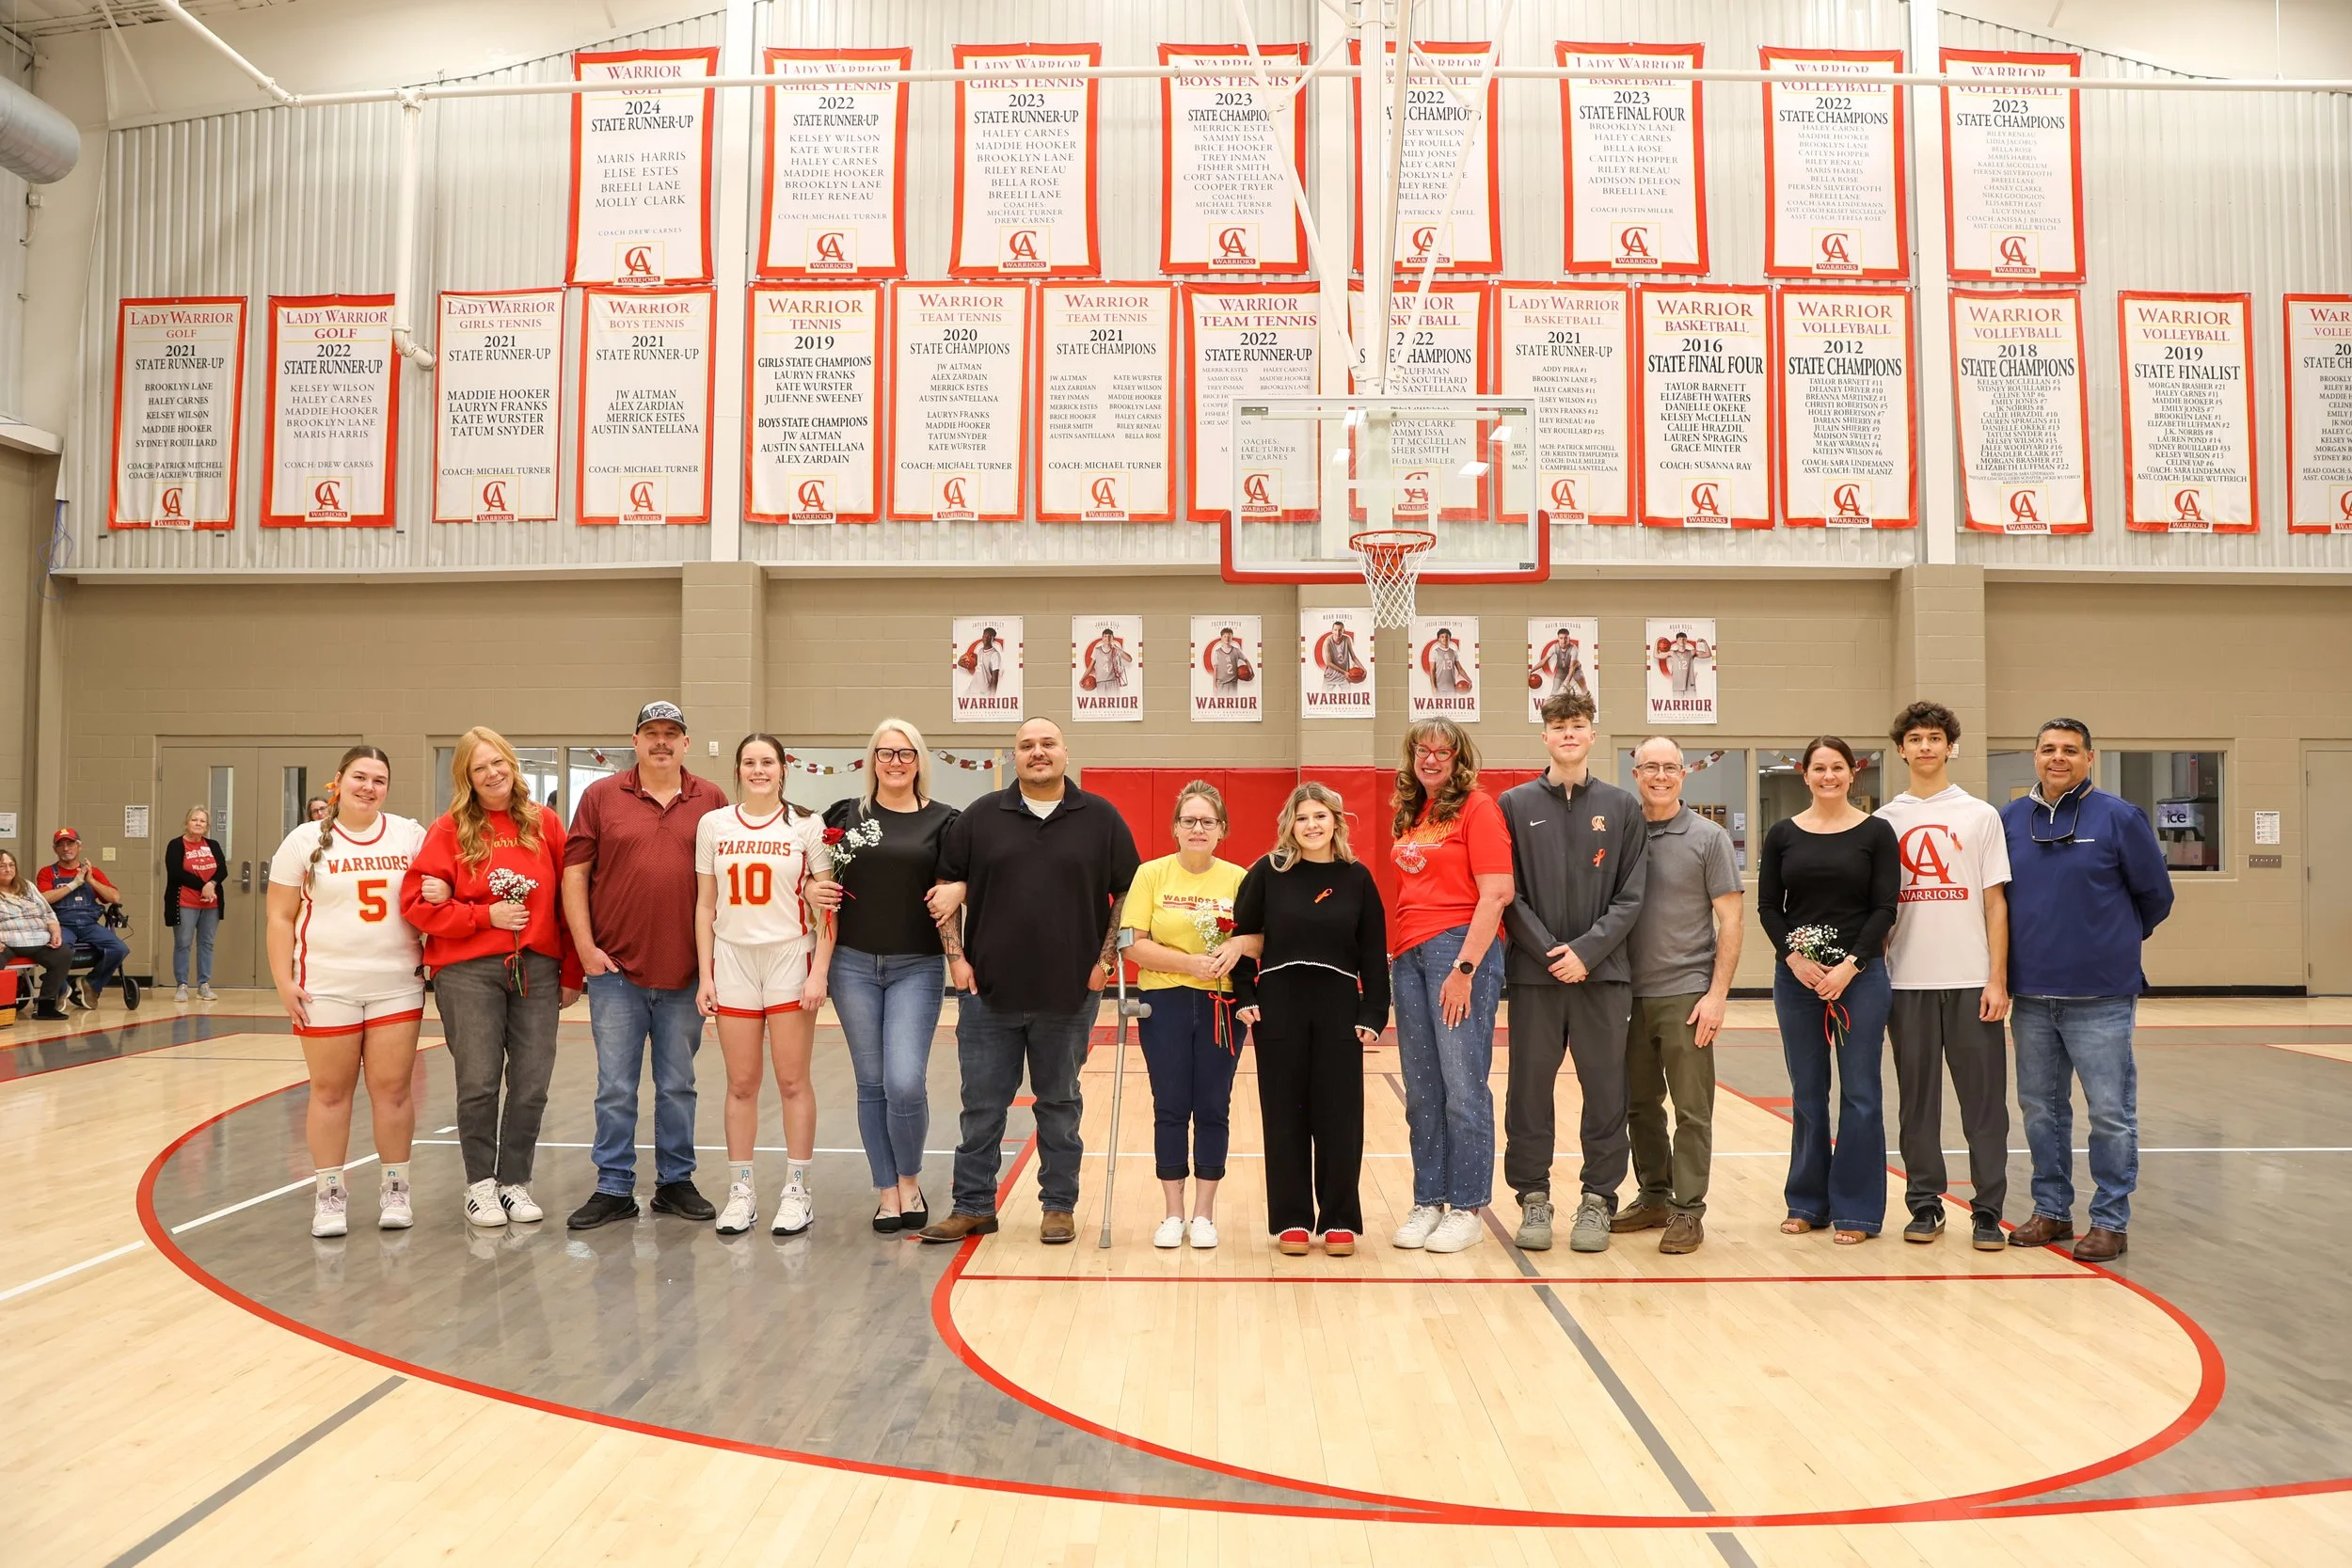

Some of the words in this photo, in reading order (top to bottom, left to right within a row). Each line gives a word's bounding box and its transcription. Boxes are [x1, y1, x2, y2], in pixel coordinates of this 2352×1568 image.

[607, 66, 681, 80] WARRIOR
[1009, 94, 1044, 107] 2023
[1216, 93, 1252, 106] 2023
[1406, 89, 1445, 103] 2022
[1613, 91, 1650, 104] 2023
[625, 101, 660, 115] 2024
[818, 97, 854, 109] 2022
[1816, 97, 1851, 110] 2022
[1993, 100, 2028, 114] 2023
[975, 111, 1009, 124] STATE
[1011, 110, 1079, 123] RUNNER-UP
[1580, 105, 1614, 119] STATE
[1617, 106, 1651, 120] FINAL
[1653, 107, 1686, 121] FOUR
[1779, 110, 1815, 122] STATE
[1817, 112, 1888, 124] CHAMPIONS
[592, 118, 626, 132] STATE
[628, 115, 693, 130] RUNNER-UP
[793, 114, 822, 126] STATE
[824, 115, 879, 126] RUNNER-UP
[1957, 113, 1992, 127] STATE
[1994, 115, 2065, 129] CHAMPIONS
[597, 153, 635, 164] MARIS
[642, 151, 686, 162] HARRIS
[977, 153, 1040, 162] BROOKLYN
[1044, 153, 1073, 162] LANE
[596, 197, 637, 207] MOLLY
[644, 195, 685, 205] CLARK
[769, 298, 863, 313] WARRIOR
[918, 293, 1003, 307] WARRIOR
[1064, 294, 1149, 308] WARRIOR
[1219, 298, 1297, 311] WARRIOR
[1508, 295, 1549, 309] LADY
[1550, 296, 1619, 310] WARRIOR
[447, 301, 486, 314] LADY
[486, 300, 555, 313] WARRIOR
[609, 301, 690, 314] WARRIOR
[1657, 300, 1753, 316] WARRIOR
[1798, 302, 1892, 318] WARRIOR
[131, 312, 168, 325] LADY
[169, 311, 233, 324] WARRIOR
[286, 311, 322, 324] LADY
[326, 309, 388, 323] WARRIOR
[920, 313, 954, 322] TEAM
[958, 313, 1001, 322] TENNIS
[1066, 313, 1100, 323] TEAM
[1104, 313, 1147, 322] TENNIS
[1200, 316, 1248, 326] TEAM
[1253, 315, 1317, 326] TENNIS
[1525, 315, 1603, 325] BASKETBALL
[1969, 307, 2062, 323] WARRIOR
[2138, 308, 2231, 325] WARRIOR
[459, 320, 494, 329] GIRLS
[498, 319, 541, 328] TENNIS
[610, 320, 640, 328] BOYS
[643, 319, 684, 328] TENNIS
[790, 319, 841, 329] TENNIS
[1665, 320, 1749, 333] BASKETBALL
[1803, 323, 1891, 335] VOLLEYBALL
[167, 329, 197, 338] GOLF
[314, 328, 357, 339] GOLF
[944, 328, 977, 341] 2020
[1090, 329, 1122, 341] 2021
[1240, 332, 1278, 345] 2022
[1548, 331, 1580, 343] 2021
[1974, 327, 2061, 339] VOLLEYBALL
[2142, 328, 2230, 341] VOLLEYBALL
[485, 336, 515, 347] 2021
[632, 336, 663, 347] 2021
[794, 336, 834, 350] 2019
[1682, 339, 1723, 353] 2016
[1823, 341, 1863, 354] 2012
[166, 345, 195, 356] 2021
[317, 344, 351, 357] 2022
[449, 350, 483, 361] STATE
[485, 348, 550, 360] RUNNER-UP
[596, 349, 630, 360] STATE
[634, 348, 699, 360] RUNNER-UP
[911, 343, 943, 354] STATE
[946, 342, 1009, 355] CHAMPIONS
[1057, 343, 1089, 355] STATE
[1091, 343, 1156, 355] CHAMPIONS
[1205, 349, 1241, 361] STATE
[1244, 348, 1312, 361] RUNNER-UP
[1516, 344, 1549, 356] STATE
[1551, 345, 1613, 357] RUNNER-UP
[1998, 344, 2037, 357] 2018
[2165, 346, 2202, 361] 2019
[135, 358, 166, 371] STATE
[168, 357, 224, 370] RUNNER-UP
[284, 360, 317, 374] STATE
[319, 359, 383, 374] RUNNER-UP
[758, 357, 784, 368] GIRLS
[786, 357, 813, 367] STATE
[815, 356, 871, 369] CHAMPIONS
[1648, 355, 1686, 372] STATE
[1689, 355, 1724, 373] FINAL
[1728, 356, 1764, 374] FOUR
[1788, 356, 1825, 374] STATE
[1827, 357, 1901, 376] CHAMPIONS
[1962, 357, 1997, 377] STATE
[1999, 357, 2074, 377] CHAMPIONS
[774, 371, 813, 380] LAURYN
[817, 371, 855, 379] FRANKS
[2135, 363, 2175, 378] STATE
[2179, 365, 2240, 380] FINALIST
[145, 383, 189, 391] BROOKLYN
[1665, 382, 1699, 390] TAYLOR
[1702, 383, 1746, 391] BARNETT
[447, 390, 496, 401] MADDIE
[500, 389, 549, 399] HOOKER
[449, 402, 498, 412] LAURYN
[501, 402, 548, 411] FRANKS
[1665, 403, 1710, 411] DANIELLE
[1713, 404, 1746, 412] OKEKE
[758, 418, 780, 428] BOYS
[782, 418, 809, 427] STATE
[811, 416, 867, 427] CHAMPIONS
[592, 424, 629, 434] AUSTIN
[632, 424, 699, 434] SANTELLANA
[958, 697, 1018, 709] WARRIOR
[1076, 696, 1138, 709] WARRIOR
[1196, 697, 1257, 709] WARRIOR
[1307, 692, 1370, 705] WARRIOR
[1414, 697, 1475, 710] WARRIOR
[1651, 699, 1711, 711] WARRIOR
[2167, 810, 2187, 823] ice
[717, 840, 791, 859] WARRIORS
[327, 855, 410, 875] WARRIORS
[727, 863, 772, 905] 10
[358, 879, 387, 922] 5
[1900, 890, 1963, 901] WARRIORS
